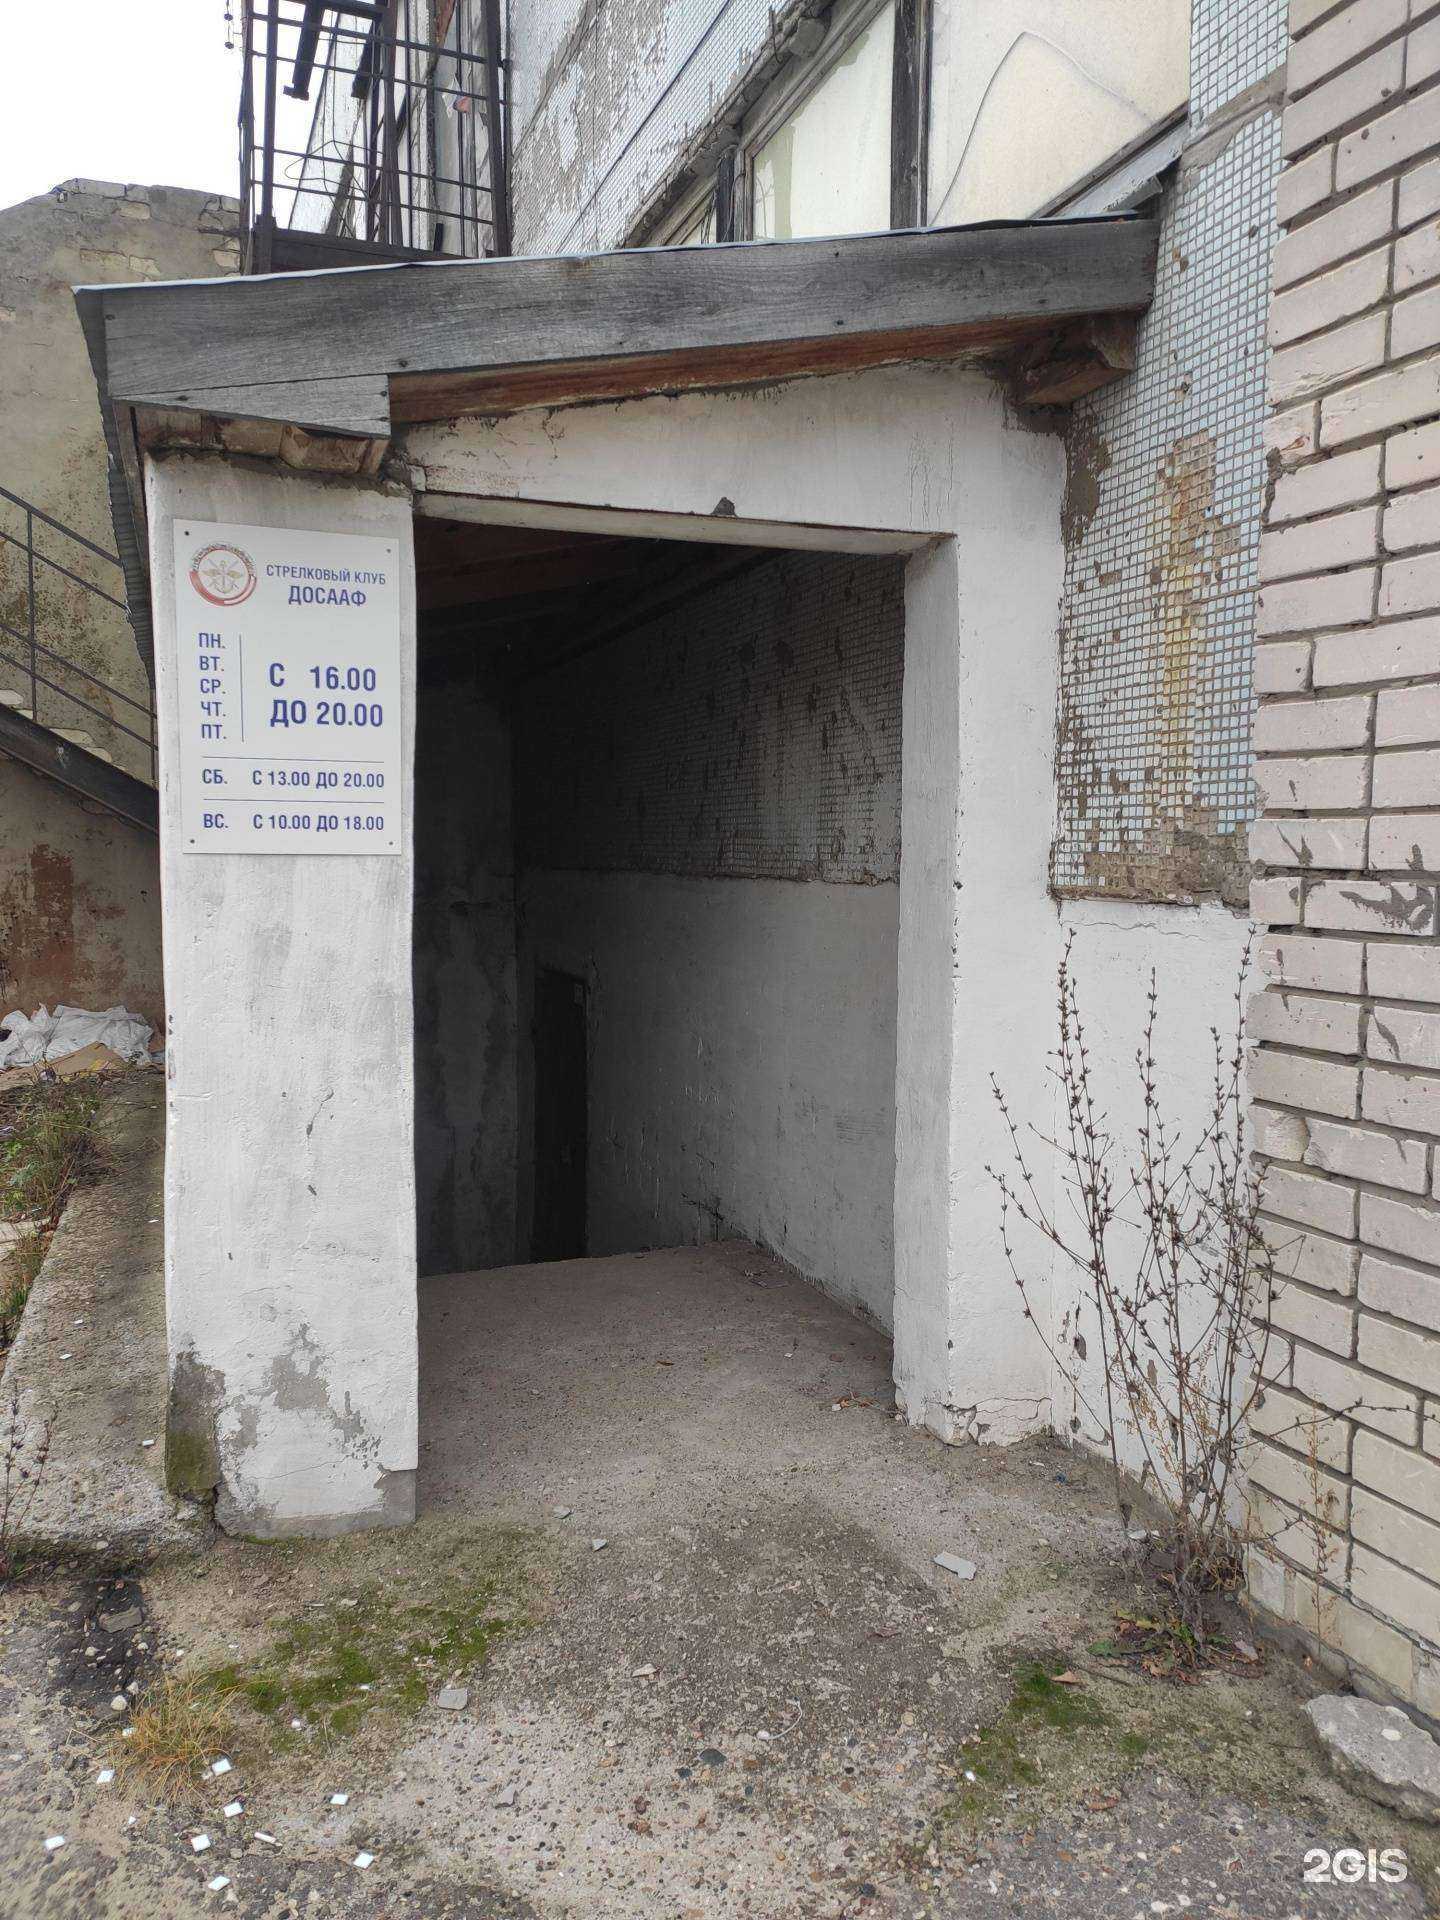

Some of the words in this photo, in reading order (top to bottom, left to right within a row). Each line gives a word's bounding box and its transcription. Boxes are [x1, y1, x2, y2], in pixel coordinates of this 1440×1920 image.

[266, 565, 351, 583] СТРЕЛКОВЫЙ
[355, 572, 386, 585] КЛУБ
[288, 585, 367, 606] ДОСААФ
[198, 632, 226, 649] ПН.
[199, 656, 225, 671] ВТ.
[200, 678, 226, 694] СР.
[269, 663, 285, 687] С
[309, 665, 377, 691] 16.00
[201, 701, 227, 717] ЧТ.
[270, 699, 307, 728] ДО
[316, 702, 384, 727] 20.00
[201, 724, 227, 740] ПТ.
[202, 769, 228, 785] СБ.
[253, 770, 262, 786] С
[268, 771, 310, 787] 13.00
[316, 772, 338, 788] ДО
[343, 772, 384, 788] 20.00
[203, 813, 229, 829] ВС.
[253, 815, 262, 830] С
[268, 815, 311, 830] 10.00
[316, 816, 339, 832] ДО
[344, 816, 384, 831] 18.00
